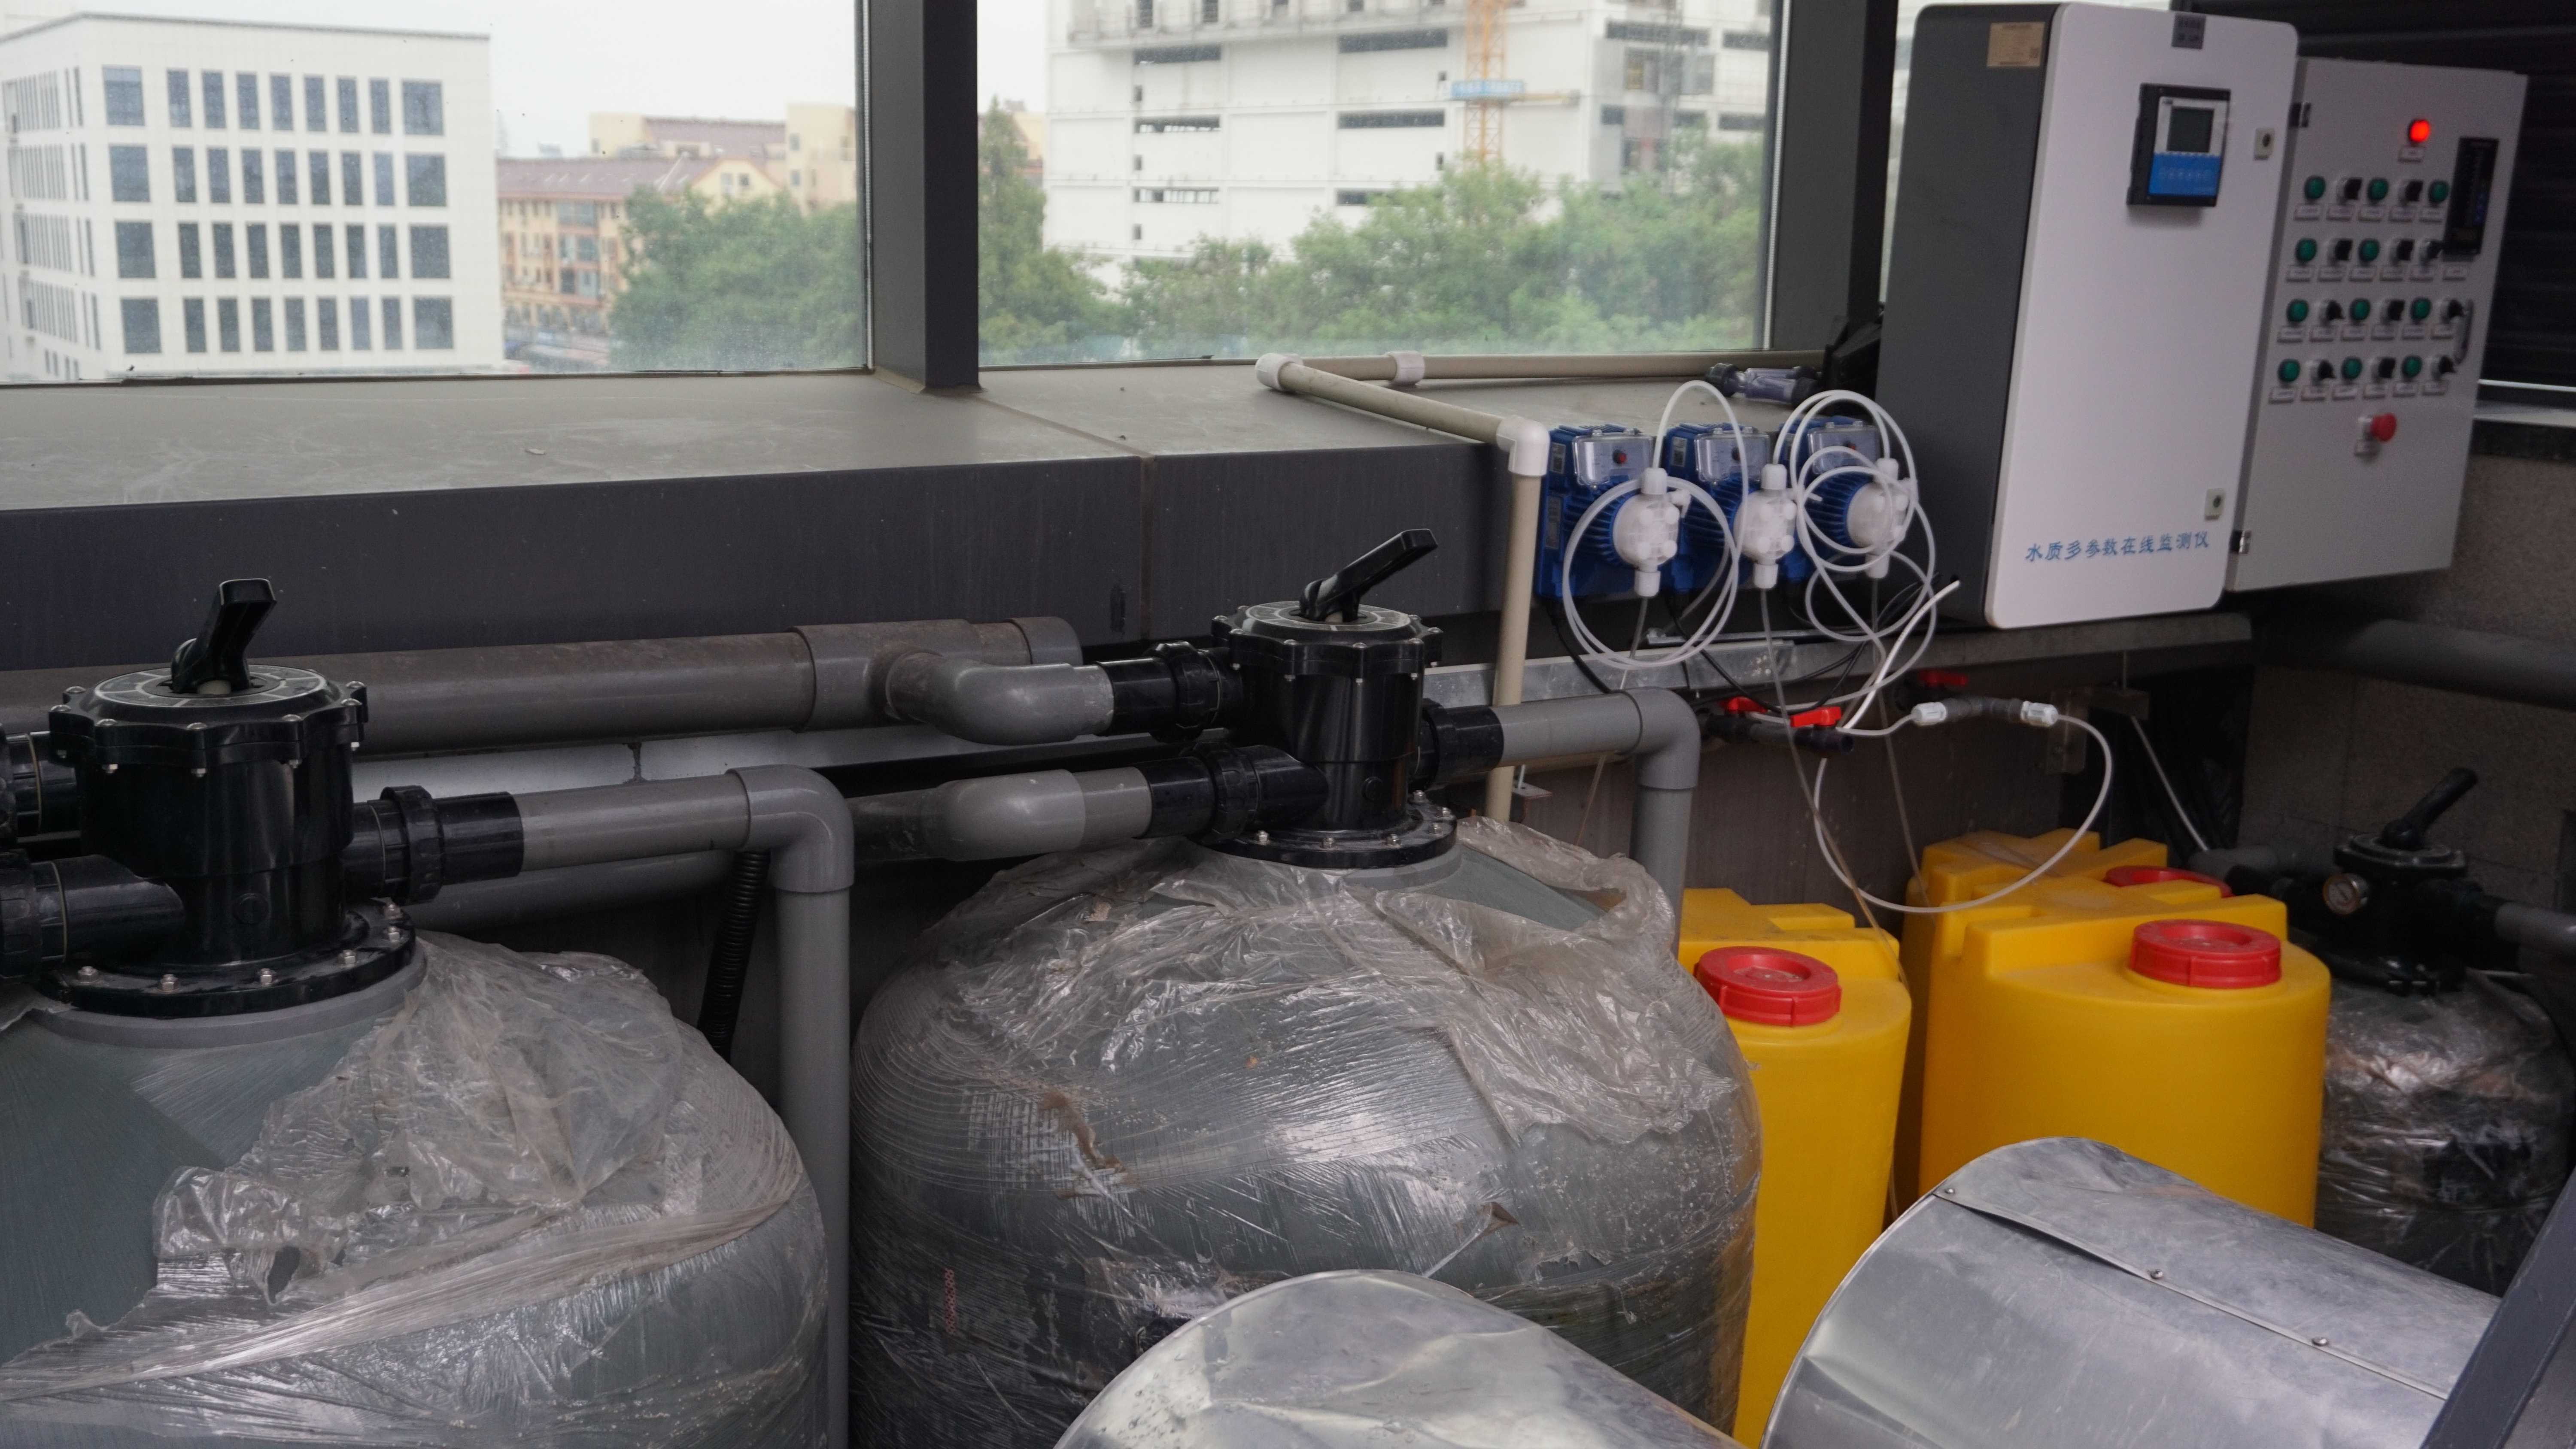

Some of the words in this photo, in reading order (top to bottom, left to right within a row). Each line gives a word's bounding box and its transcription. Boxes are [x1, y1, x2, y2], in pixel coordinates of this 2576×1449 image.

[2026, 531, 2209, 562] 水质多参数在线监测仪
